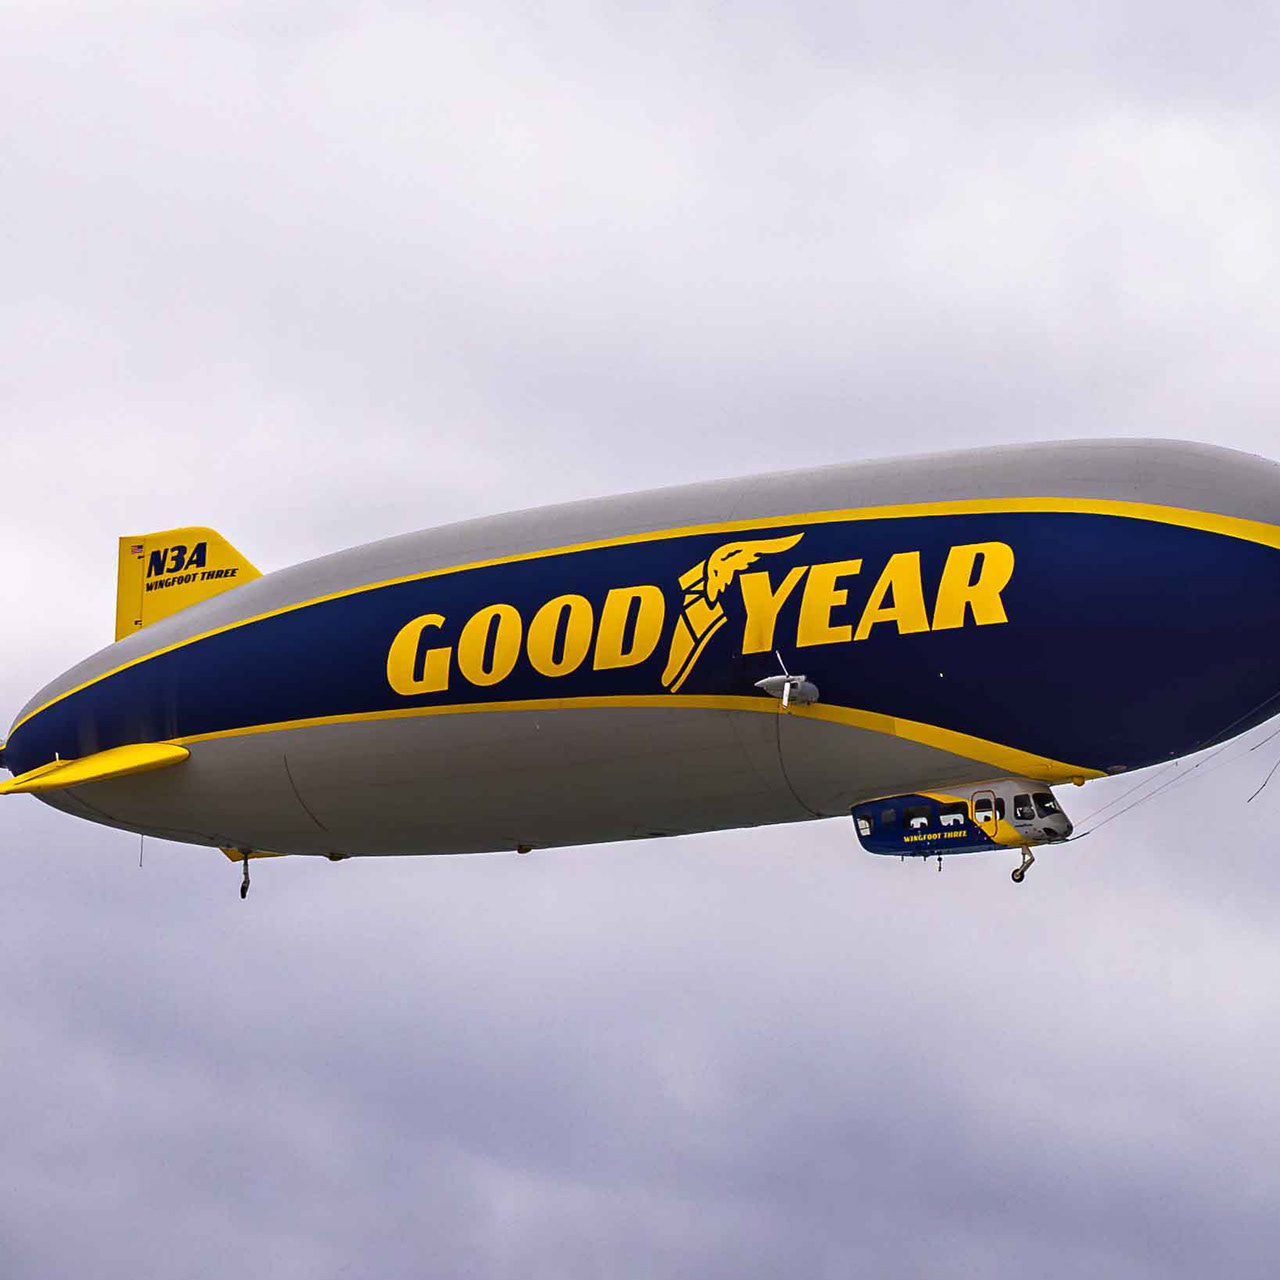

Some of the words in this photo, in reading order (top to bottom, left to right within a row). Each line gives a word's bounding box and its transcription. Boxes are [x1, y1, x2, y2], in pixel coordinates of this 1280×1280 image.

[146, 542, 208, 578] N3A
[145, 573, 198, 592] WINGFOOT
[200, 568, 239, 581] THREE
[903, 833, 941, 842] WINGFOOT
[944, 830, 967, 839] THREE
